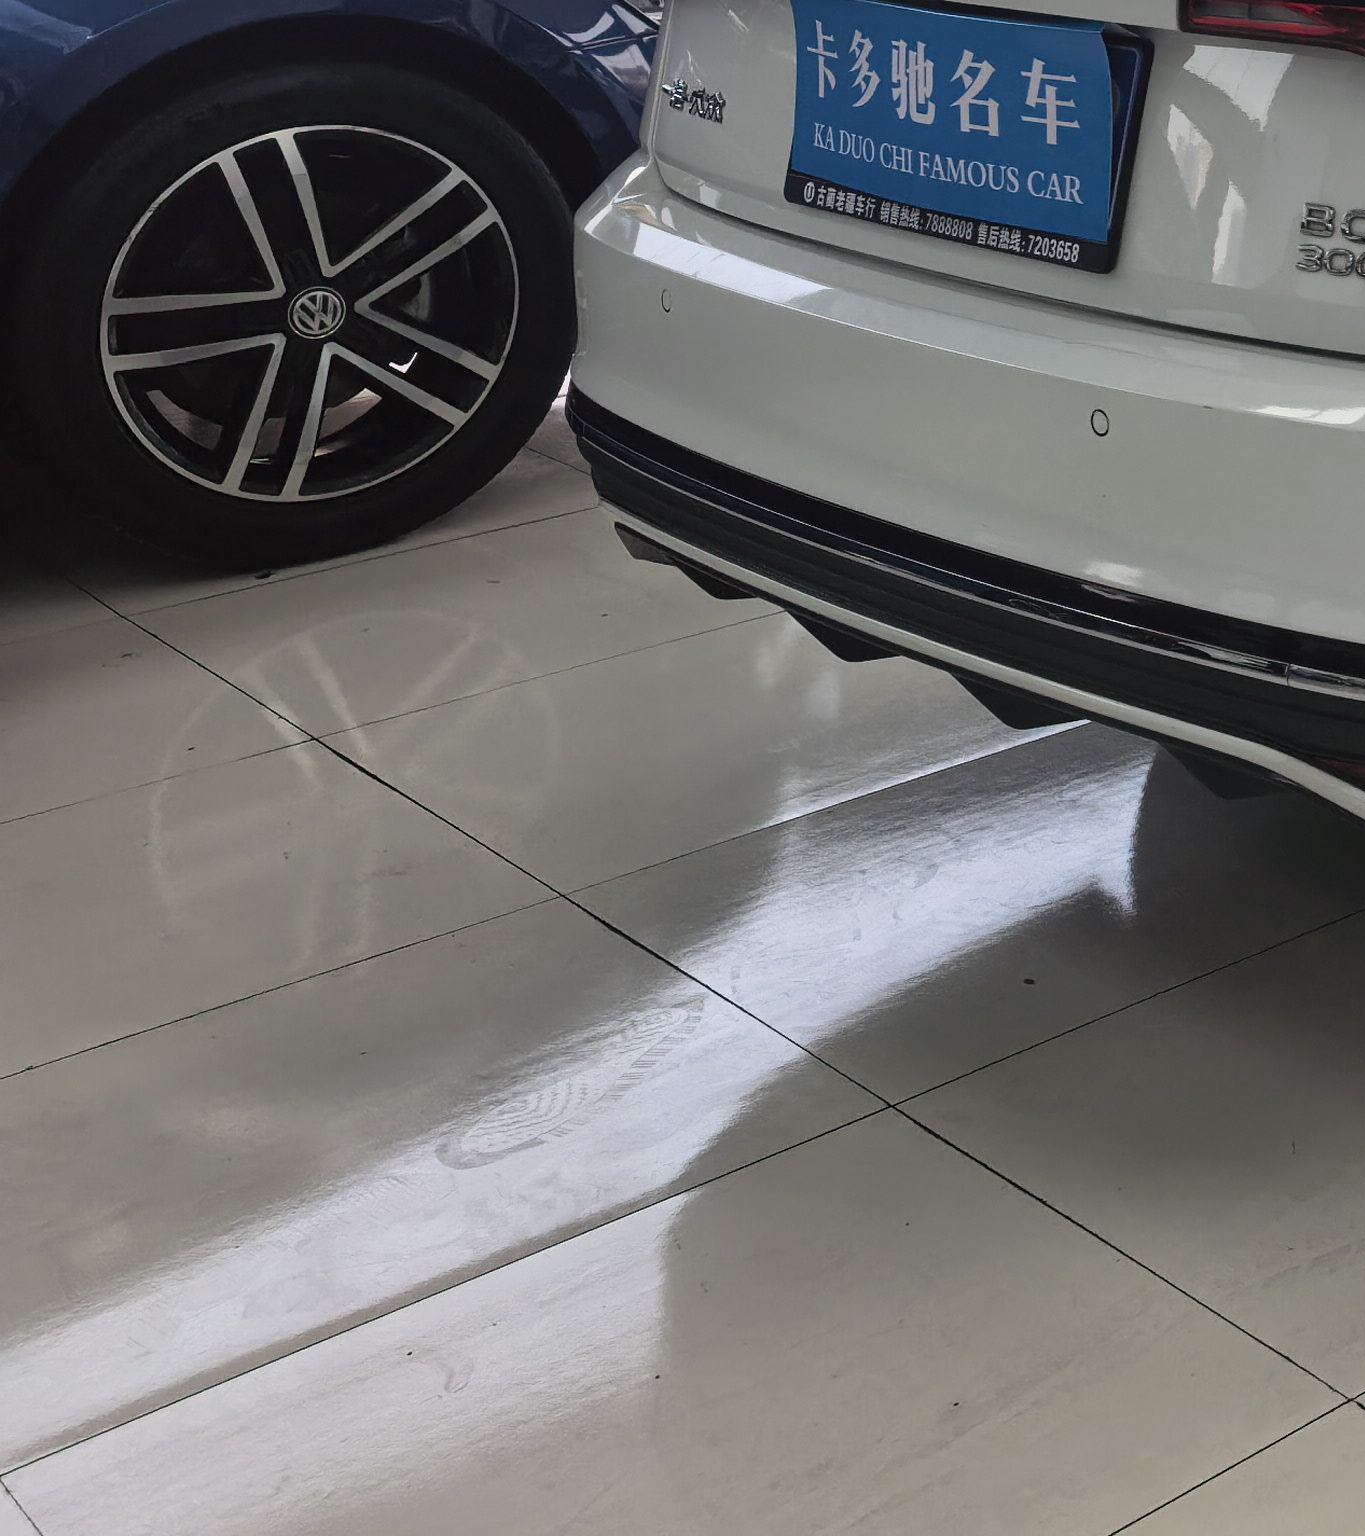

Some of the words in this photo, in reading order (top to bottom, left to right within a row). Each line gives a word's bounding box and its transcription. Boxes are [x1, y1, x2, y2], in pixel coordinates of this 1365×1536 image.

[807, 20, 1080, 145] 卡多驰名车
[813, 122, 836, 152] KA
[838, 130, 875, 163] DUO
[879, 142, 914, 175] CHI
[919, 151, 1020, 194] FAMOUS
[1027, 170, 1085, 205] CAR
